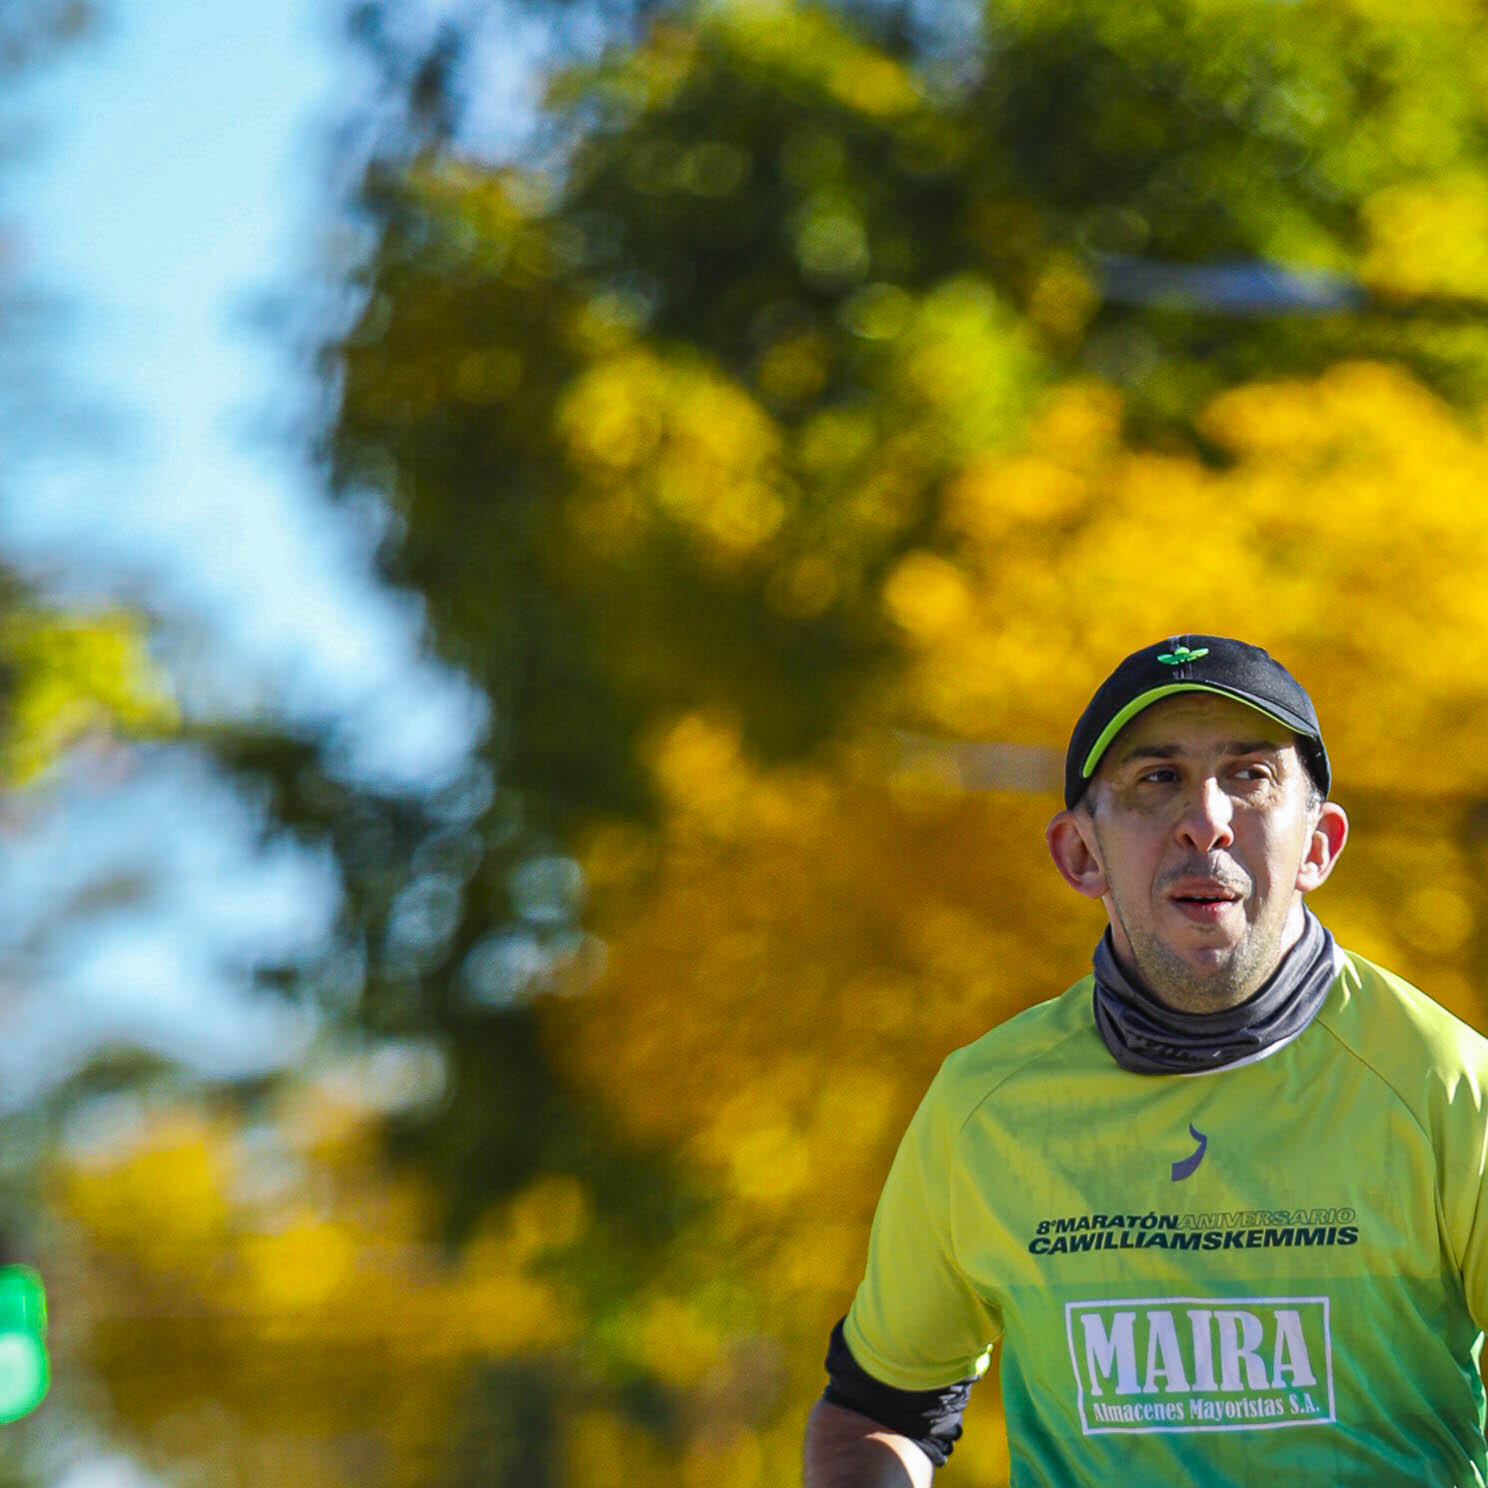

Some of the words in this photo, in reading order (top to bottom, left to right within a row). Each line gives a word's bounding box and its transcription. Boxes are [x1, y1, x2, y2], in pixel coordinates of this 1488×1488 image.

[1028, 1226, 1359, 1255] CAWILLIAMSKEMMIS
[1080, 1310, 1317, 1396] MAIRA
[1092, 1401, 1184, 1422] Almacenes
[1189, 1397, 1284, 1422] Mayoristas
[1289, 1393, 1321, 1415] S.A.
